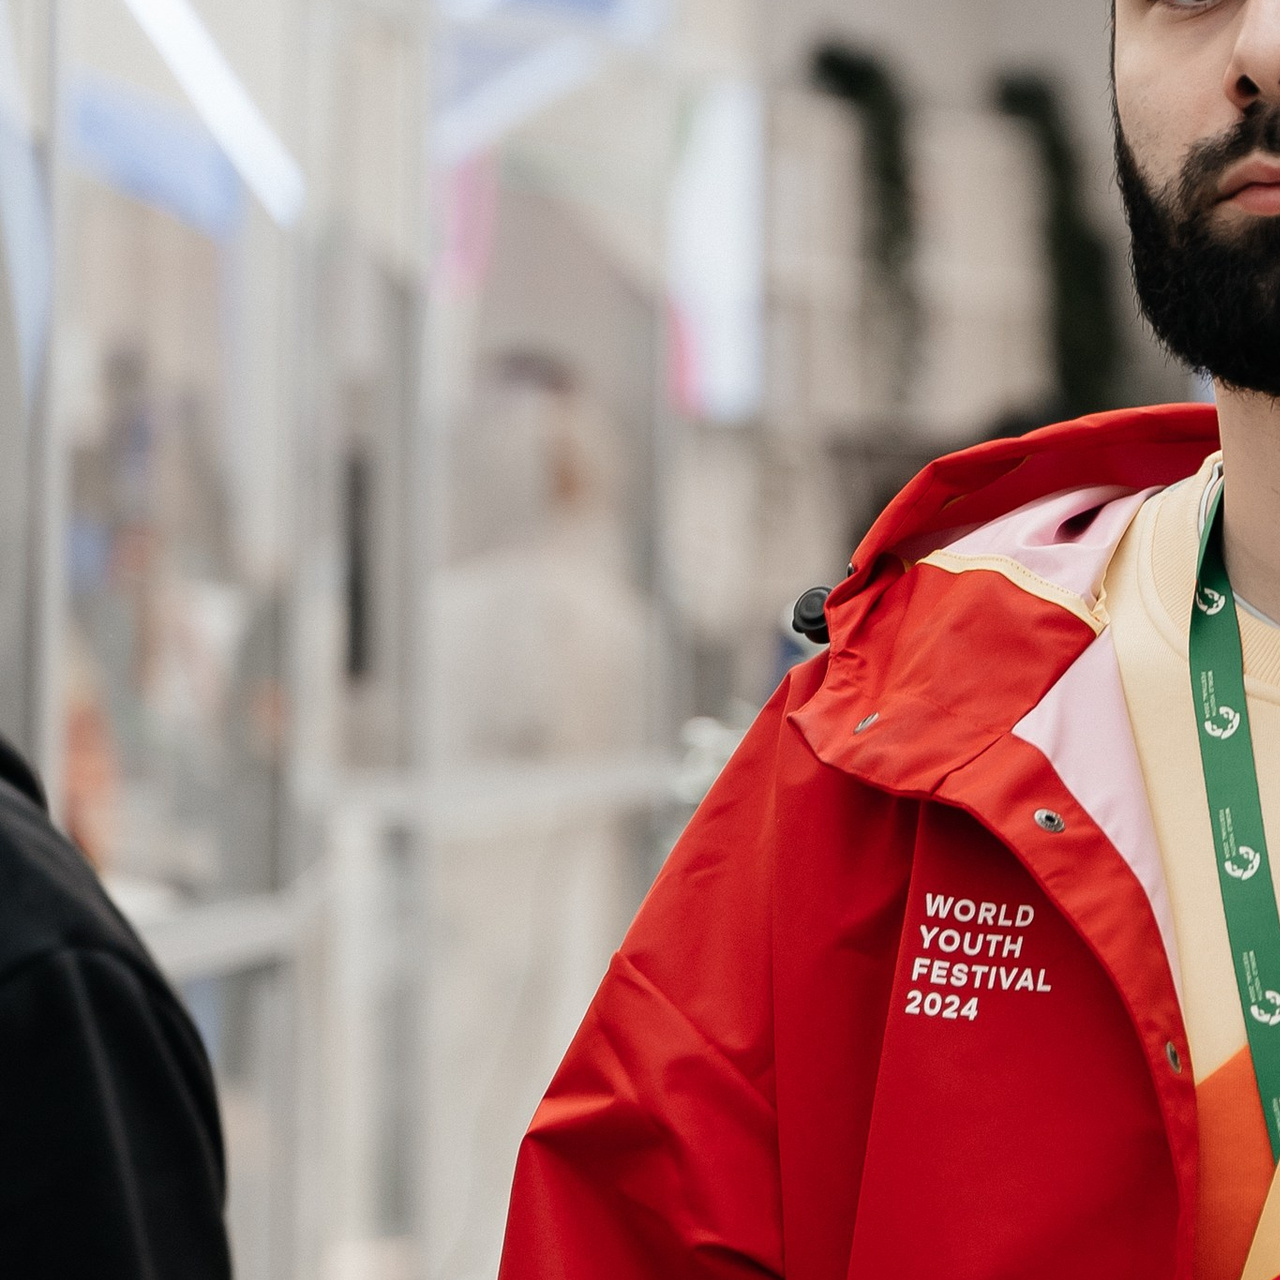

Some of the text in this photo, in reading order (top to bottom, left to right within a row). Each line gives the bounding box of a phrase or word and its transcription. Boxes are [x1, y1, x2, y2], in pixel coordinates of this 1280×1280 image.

[925, 892, 1035, 927] WORLD
[919, 924, 1023, 958] YOUTH
[911, 957, 1052, 992] FESTIVAL
[905, 989, 979, 1021] 2024
